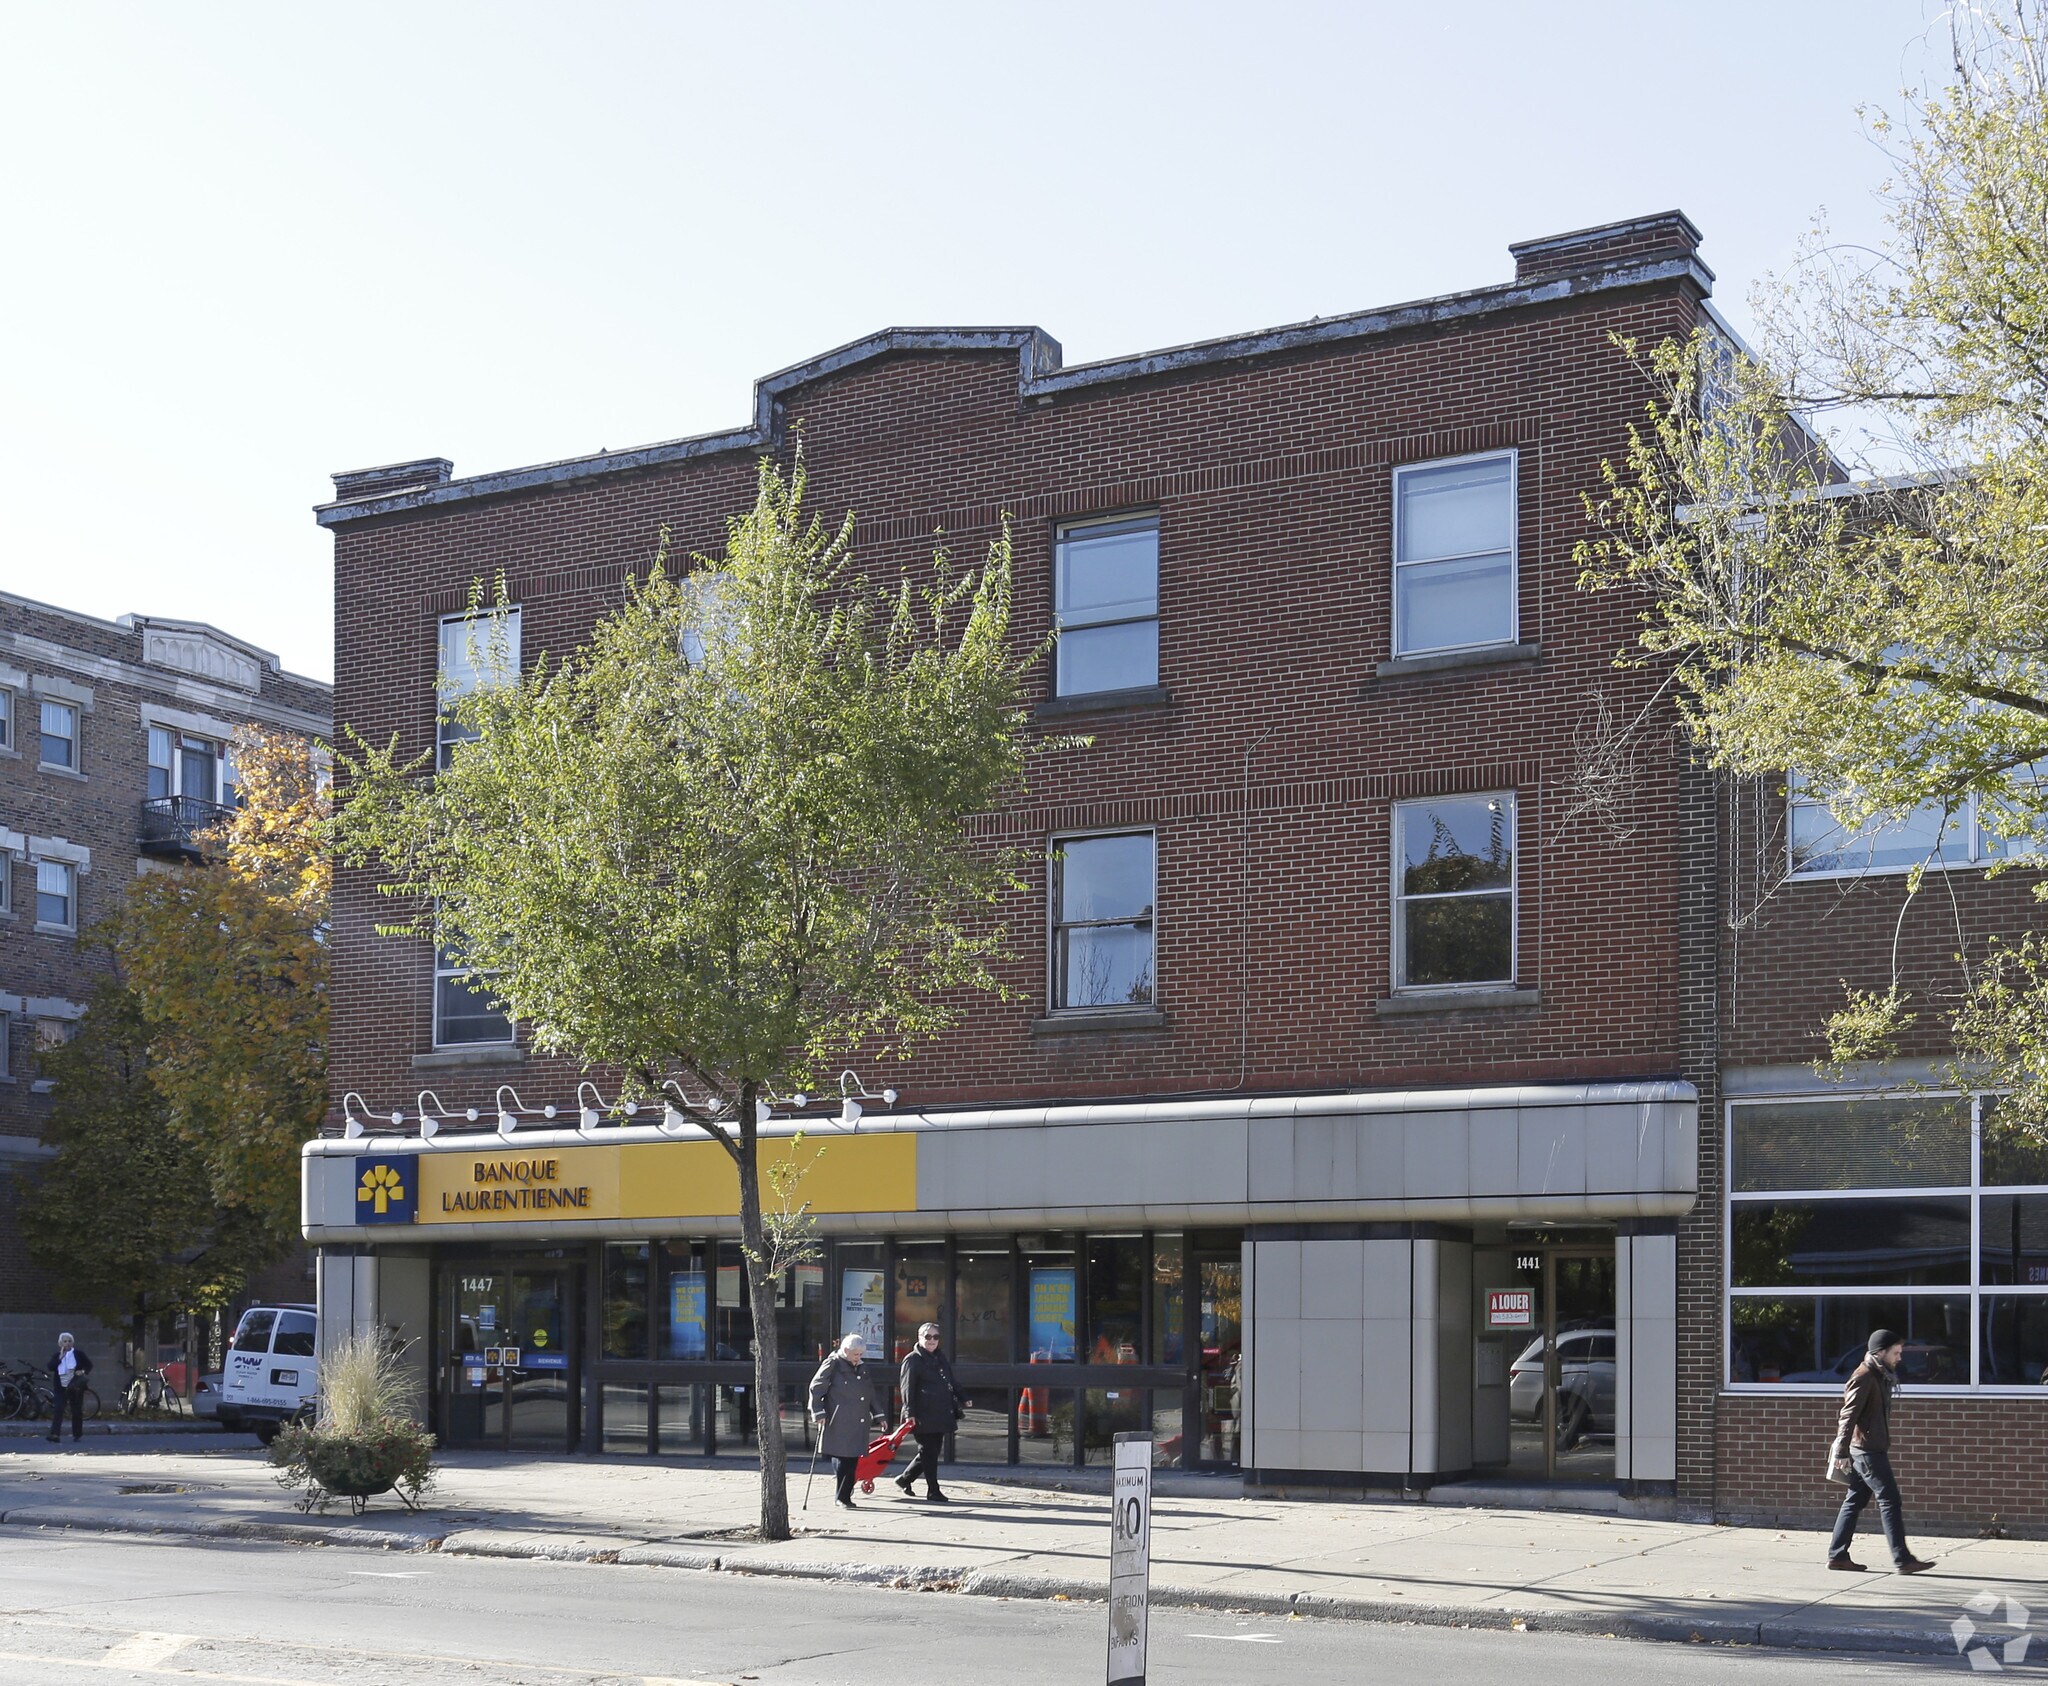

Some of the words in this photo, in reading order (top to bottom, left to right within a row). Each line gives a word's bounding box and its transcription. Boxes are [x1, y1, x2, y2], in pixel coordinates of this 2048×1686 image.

[474, 1160, 558, 1185] BANQUE
[442, 1187, 590, 1212] LAURENTIENNE
[1517, 1257, 1540, 1269] 1441
[462, 1278, 493, 1292] 1447
[1499, 1294, 1529, 1310] LOUER
[1115, 1496, 1141, 1541] 40
